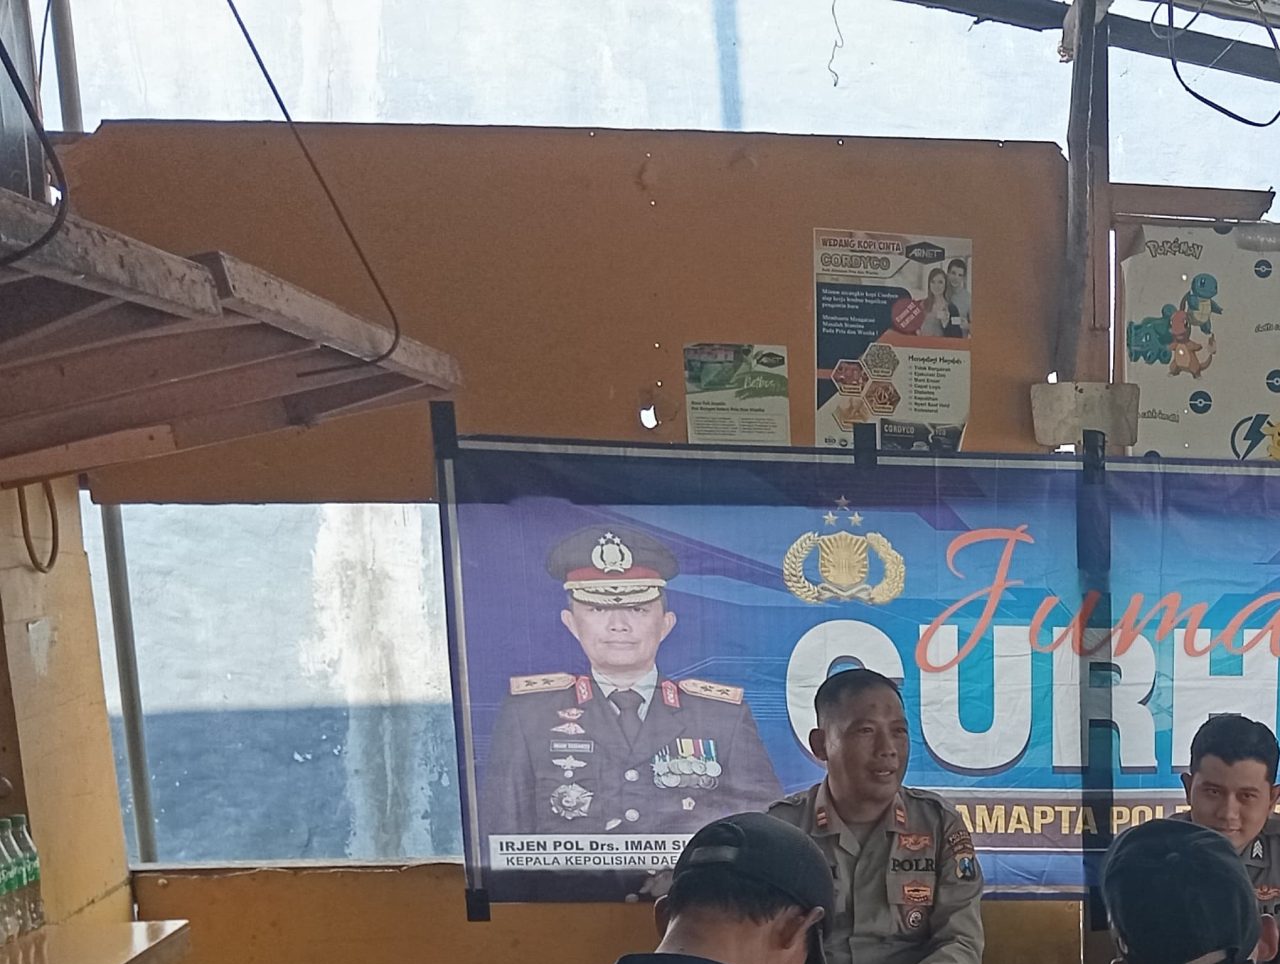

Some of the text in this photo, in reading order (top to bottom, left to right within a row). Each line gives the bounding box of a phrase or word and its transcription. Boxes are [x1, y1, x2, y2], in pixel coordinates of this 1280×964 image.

[857, 240, 876, 250] KOPI
[878, 241, 902, 252] CINTA
[820, 252, 891, 270] CORDYCO
[500, 841, 547, 851] IRJEN
[553, 840, 584, 851] POL
[589, 840, 619, 851] Drs.
[625, 840, 666, 850] IMAM
[506, 856, 560, 866] KEPALA
[565, 855, 646, 866] KEPOLISIAN
